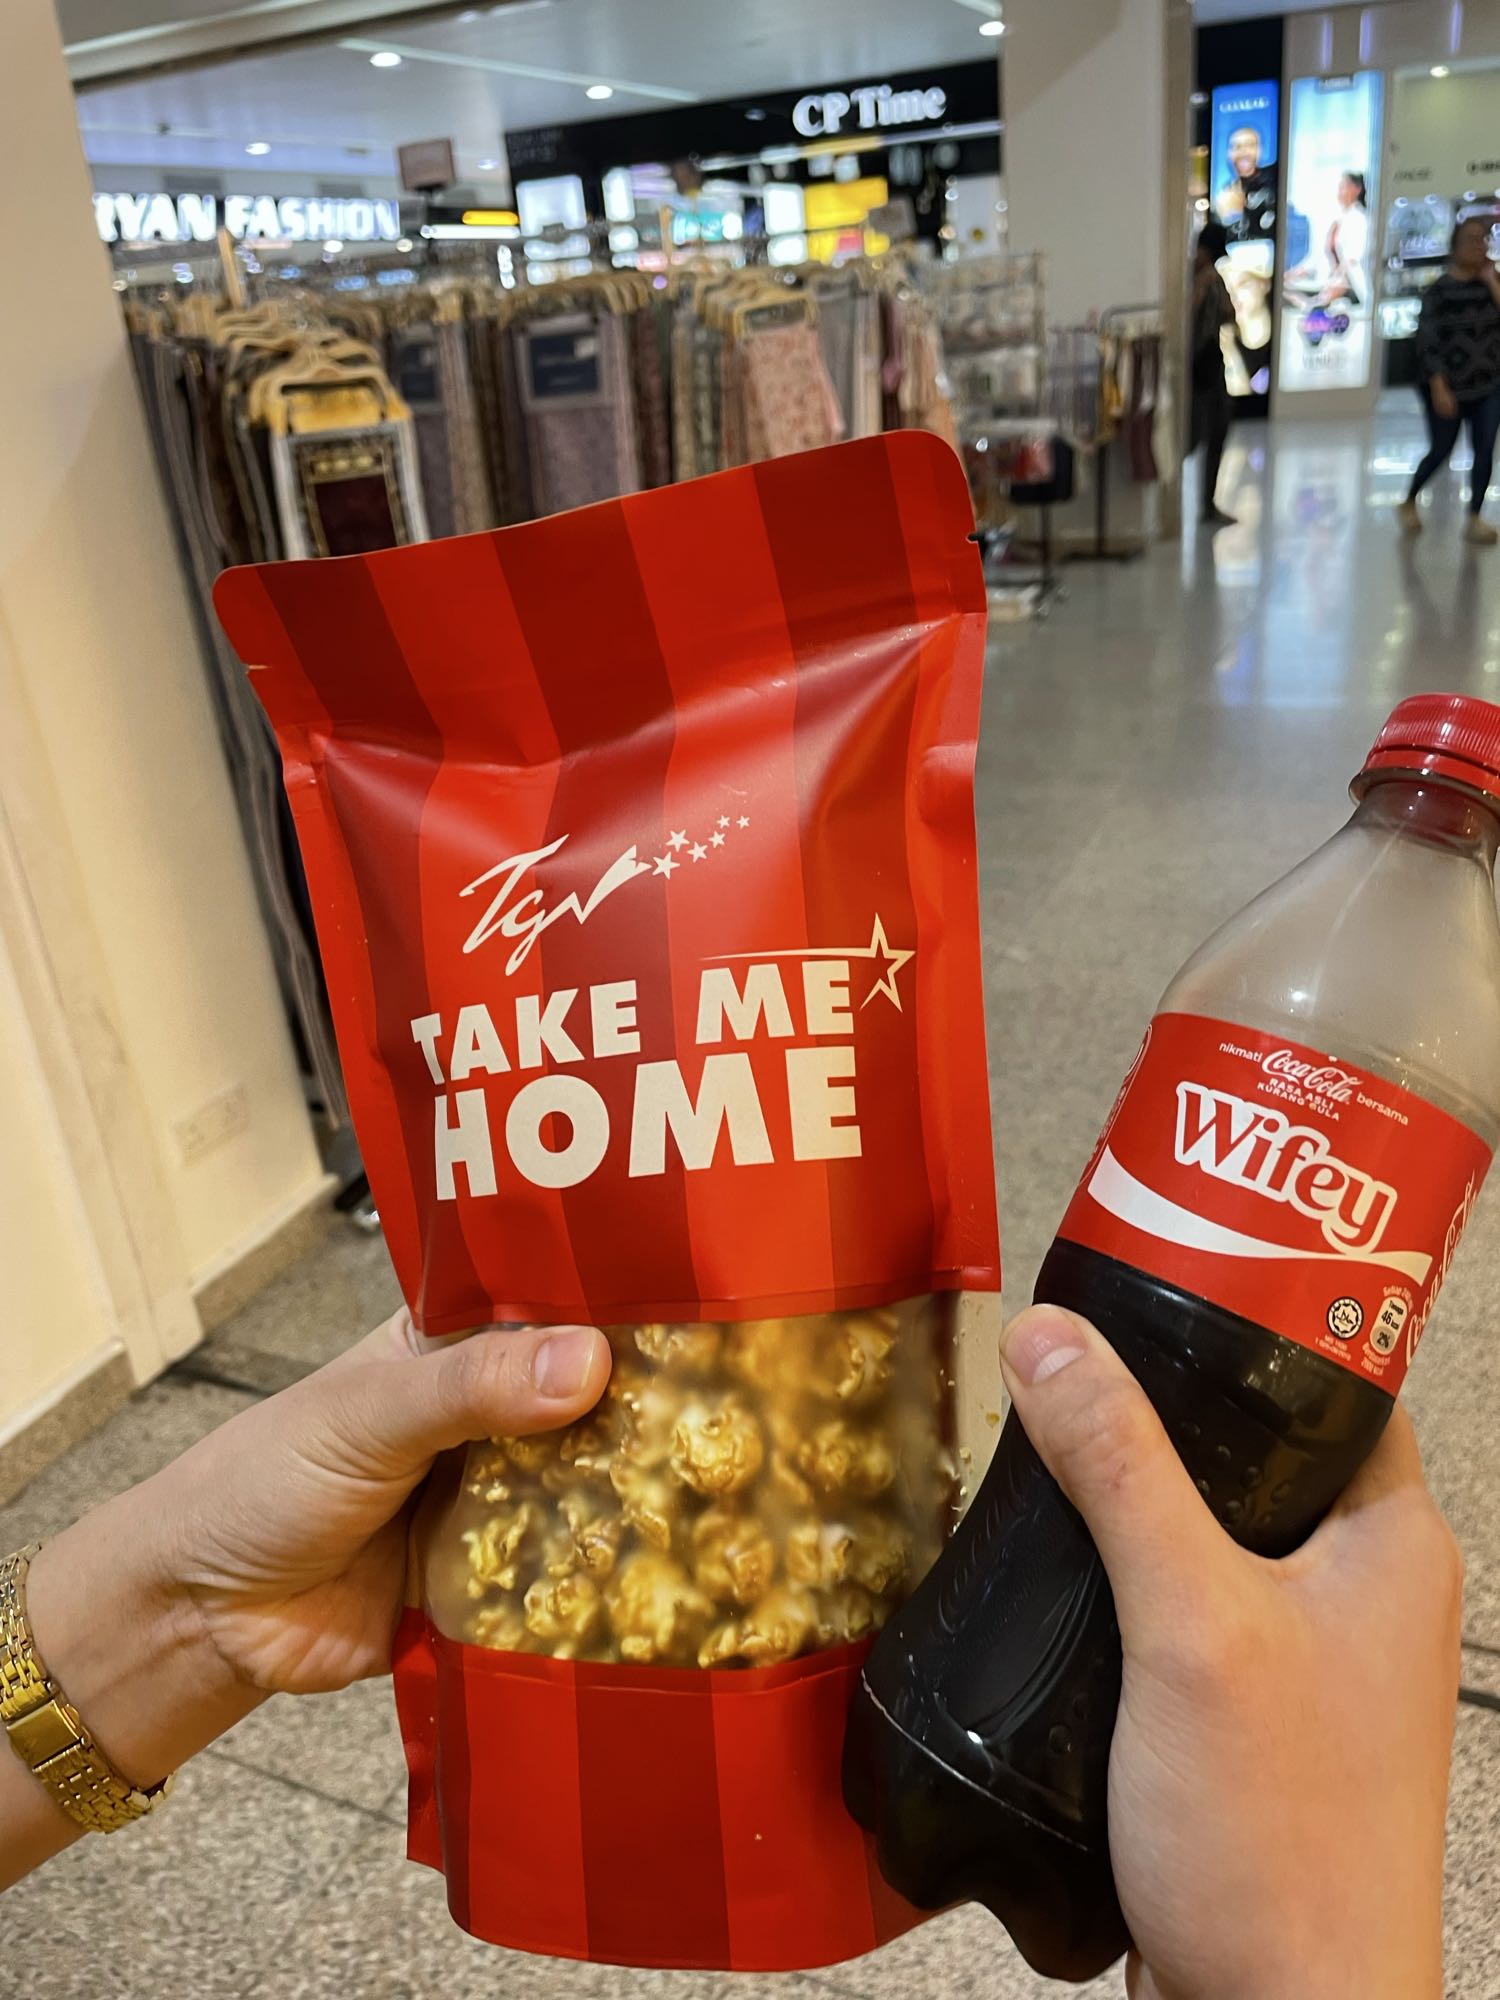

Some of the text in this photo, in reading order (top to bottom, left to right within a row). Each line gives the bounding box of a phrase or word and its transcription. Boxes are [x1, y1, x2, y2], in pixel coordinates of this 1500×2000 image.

[793, 84, 946, 137] CP Time
[225, 194, 400, 242] FASHION
[410, 960, 854, 1085] TAKE ME
[1219, 1042, 1263, 1063] nikmati
[1356, 1092, 1409, 1126] bersama
[1257, 1081, 1306, 1107] KURANG
[1269, 1078, 1334, 1110] RASA ASLI
[434, 1046, 862, 1200] HOME
[1175, 1081, 1398, 1254] Wifey
[1381, 1310, 1393, 1325] 46
